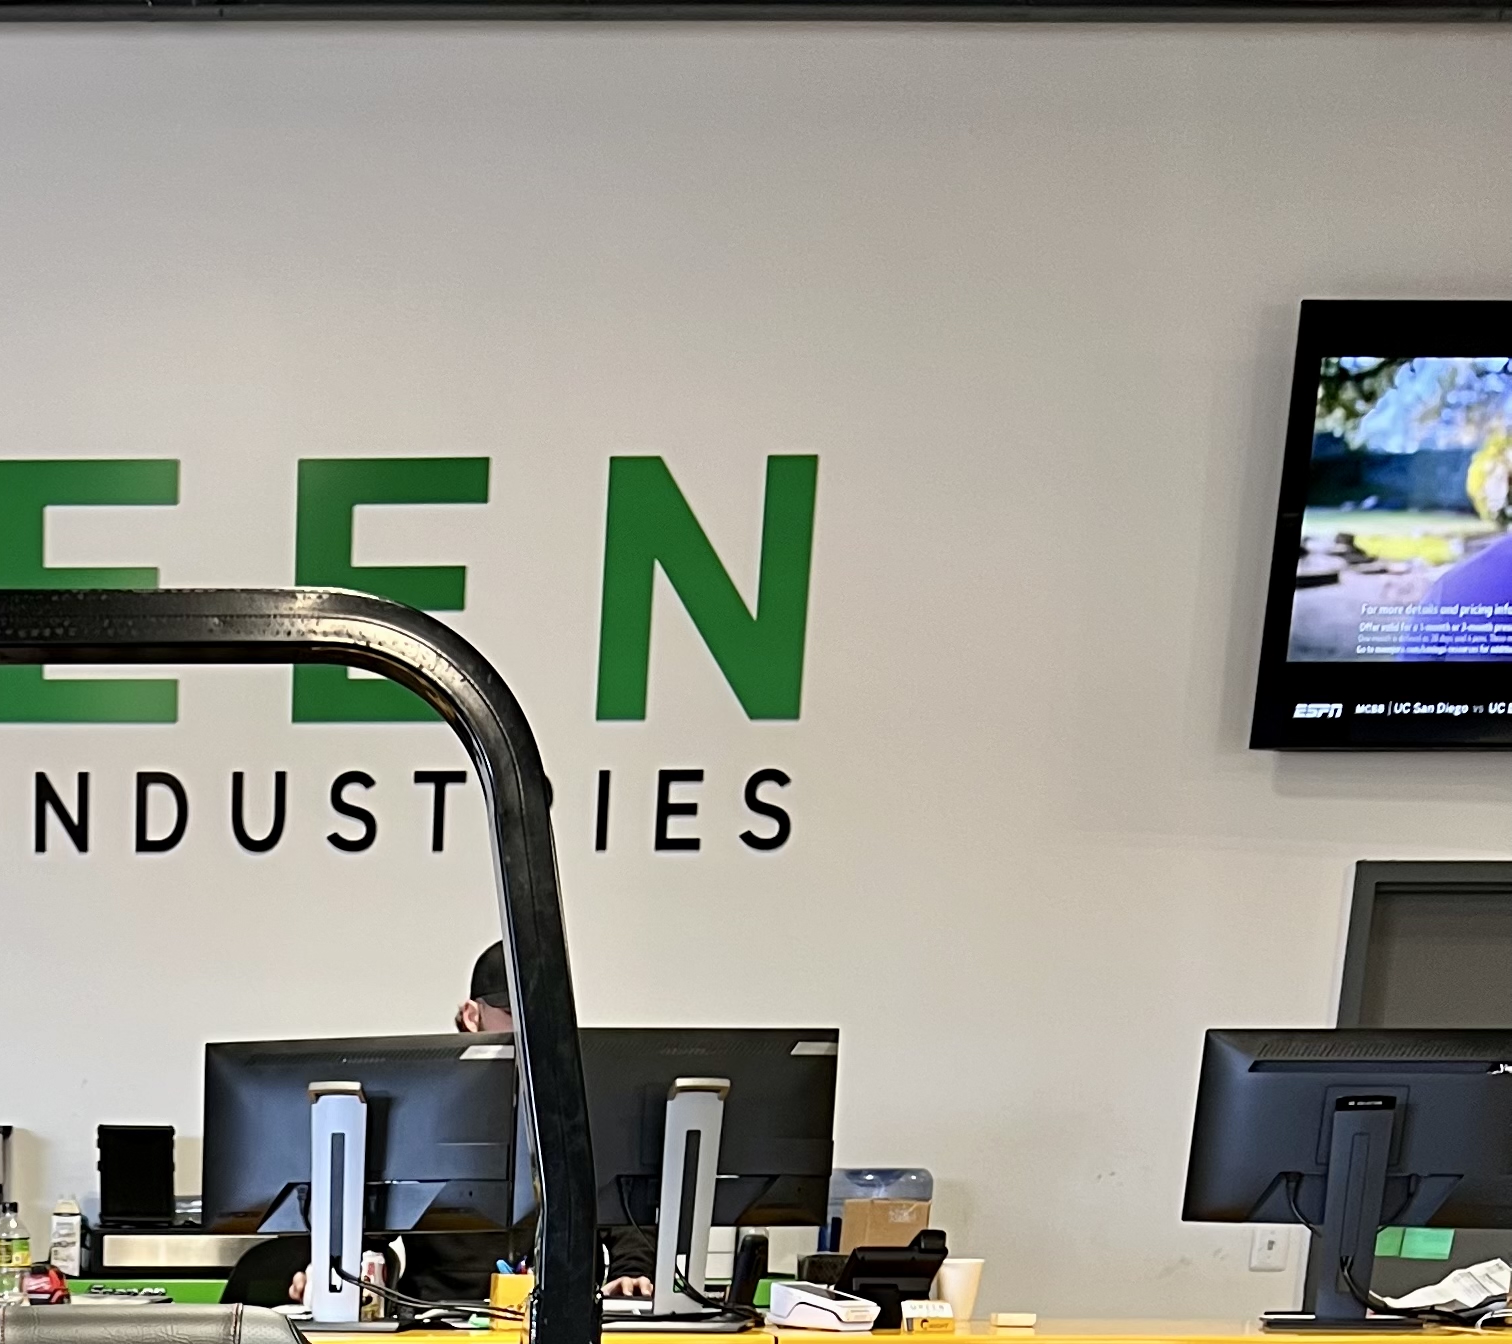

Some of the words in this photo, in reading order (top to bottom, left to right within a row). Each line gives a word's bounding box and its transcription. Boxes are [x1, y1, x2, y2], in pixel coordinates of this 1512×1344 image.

[1292, 703, 1344, 719] ESPN
[1393, 702, 1411, 714] UC
[1413, 702, 1435, 714] San
[1436, 702, 1469, 716] Diego
[1472, 705, 1484, 713] vs
[1488, 702, 1506, 714] UC
